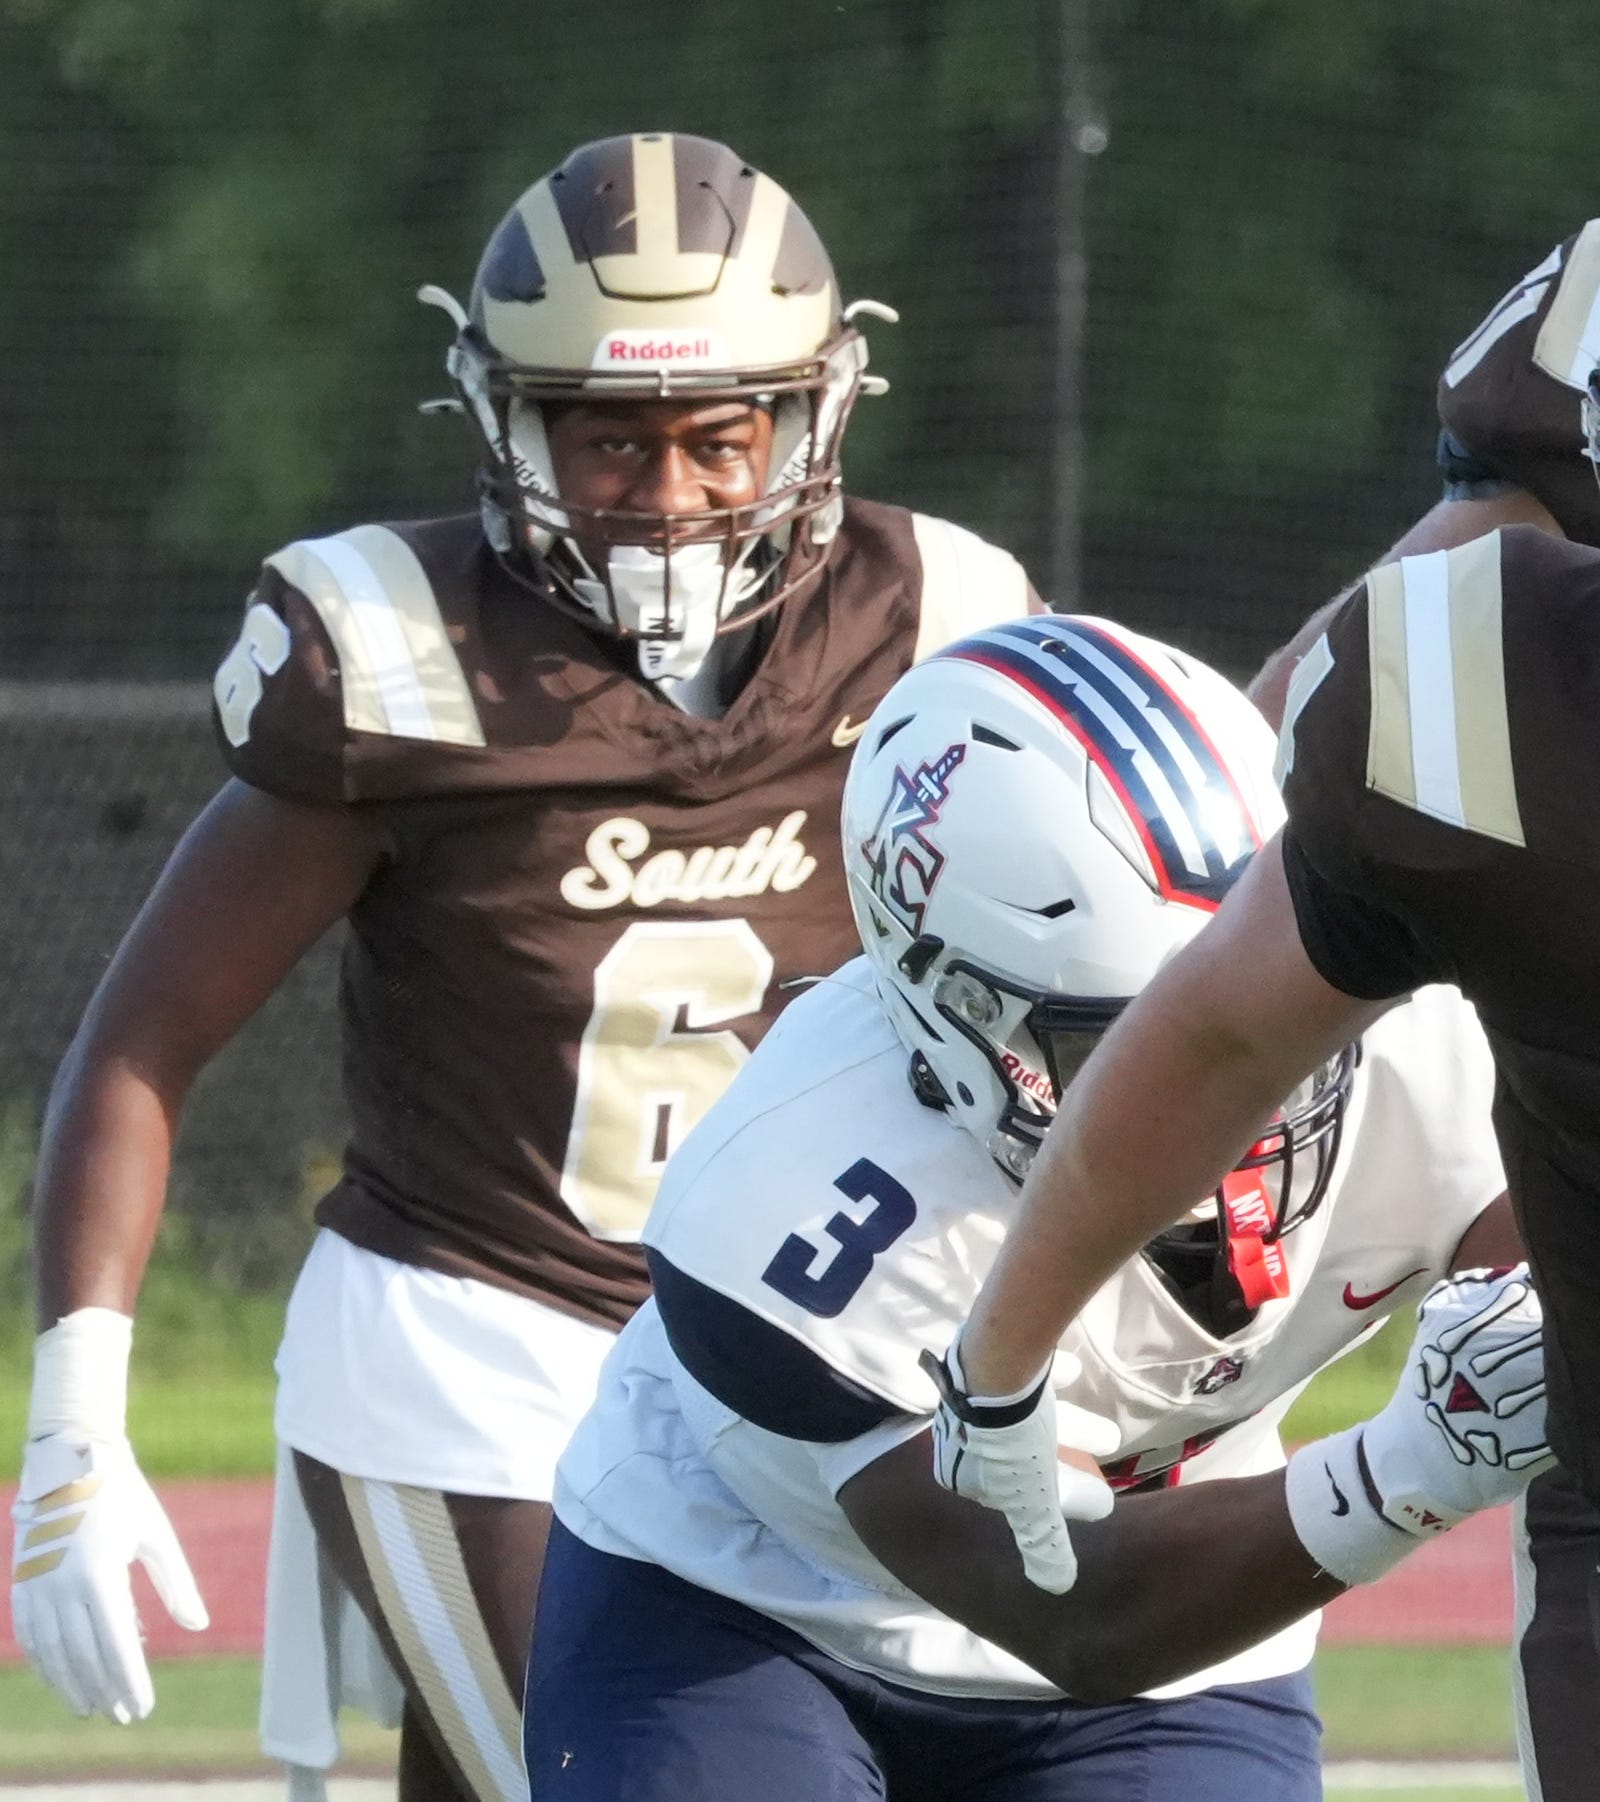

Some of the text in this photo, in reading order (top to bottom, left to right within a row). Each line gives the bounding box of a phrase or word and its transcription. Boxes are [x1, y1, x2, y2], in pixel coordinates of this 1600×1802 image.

[609, 340, 709, 360] Riddell
[213, 602, 292, 748] 6
[560, 810, 817, 910] South
[559, 918, 775, 1244] 6
[761, 1156, 917, 1319] 3
